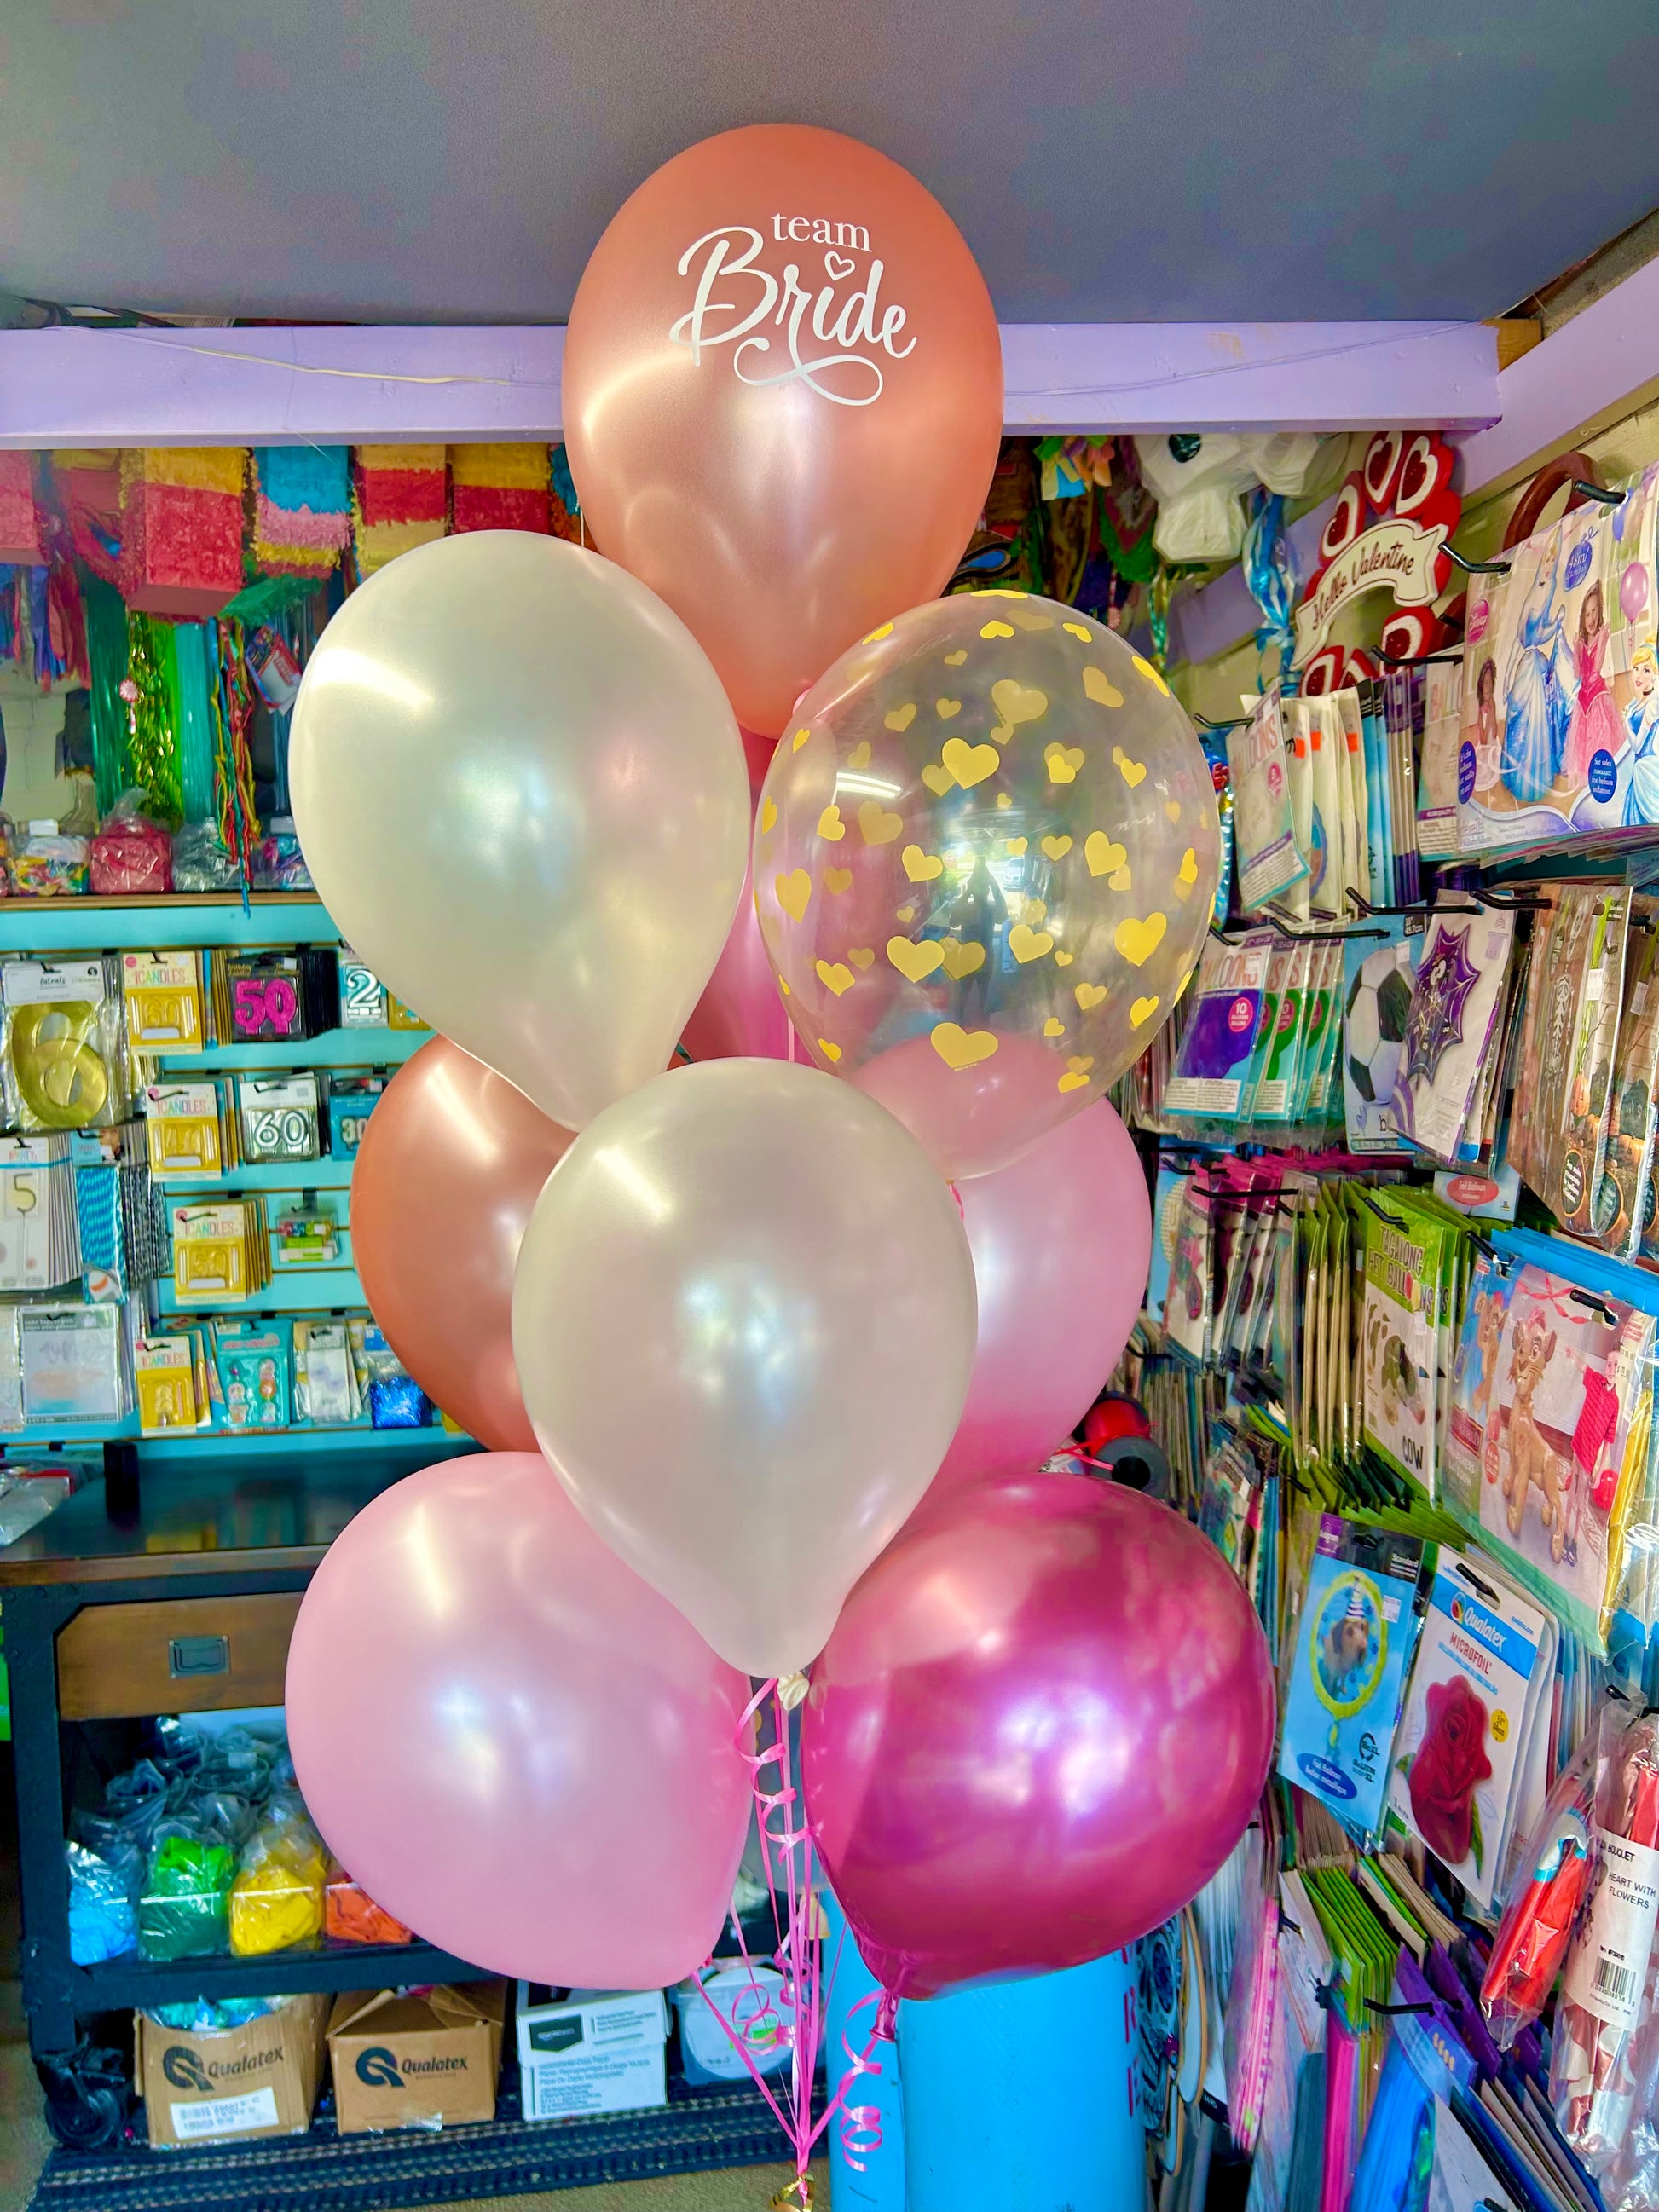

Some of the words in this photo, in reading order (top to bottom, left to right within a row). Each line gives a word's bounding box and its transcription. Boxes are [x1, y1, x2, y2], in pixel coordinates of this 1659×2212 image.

[771, 212, 873, 253] team
[669, 225, 918, 407] Bride
[1313, 570, 1347, 631] Hello
[1351, 540, 1416, 586] Valentine
[1467, 611, 1488, 632] Disney
[1593, 757, 1602, 765] See
[1601, 758, 1612, 767] sales
[1598, 776, 1614, 786] helium
[234, 978, 297, 1027] 50
[346, 968, 382, 1008] 2
[1235, 1002, 1247, 1014] 10
[11, 1001, 108, 1128] 6
[255, 1111, 308, 1148] 60
[14, 1172, 37, 1212] 5
[1367, 1247, 1385, 1276] PET
[1380, 1224, 1425, 1278] TAGALONG
[1402, 1435, 1425, 1470] COW
[1391, 1552, 1419, 1568] Standard
[1465, 1607, 1507, 1653] Qualatex
[1607, 1845, 1636, 1863] BOUQUET
[1609, 1873, 1633, 1890] HEART
[1634, 1882, 1657, 1898] WITH
[1609, 1886, 1650, 1909] FLOWERS
[208, 2047, 285, 2080] Qualatex
[402, 2055, 469, 2076] Qualatex
